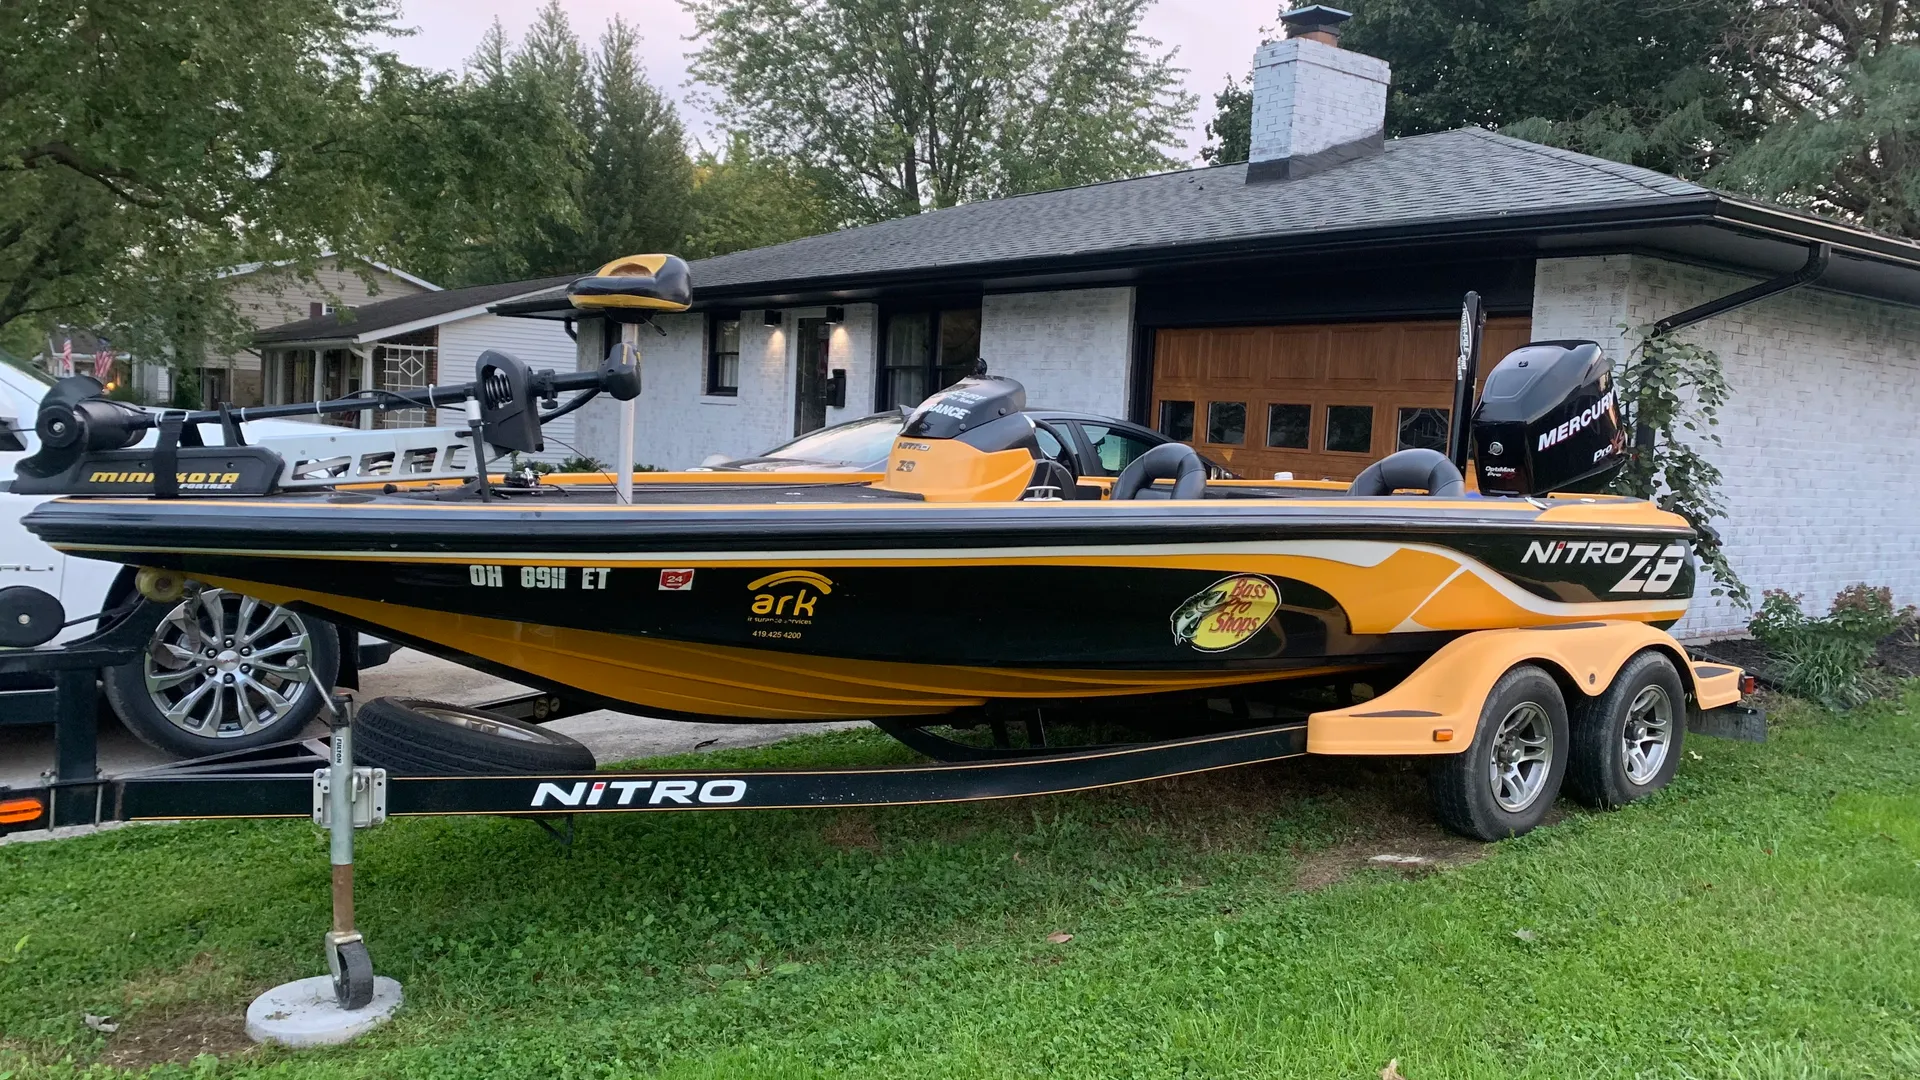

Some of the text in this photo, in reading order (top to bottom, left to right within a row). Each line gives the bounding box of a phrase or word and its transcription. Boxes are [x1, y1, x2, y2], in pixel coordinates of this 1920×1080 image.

[469, 565, 611, 590] OH 8911 ET
[667, 575, 683, 583] 24
[1609, 544, 1686, 593] Z8
[1228, 578, 1270, 599] Bass
[751, 589, 818, 617] ark
[1226, 596, 1253, 615] Pro
[1209, 611, 1261, 638] Shops
